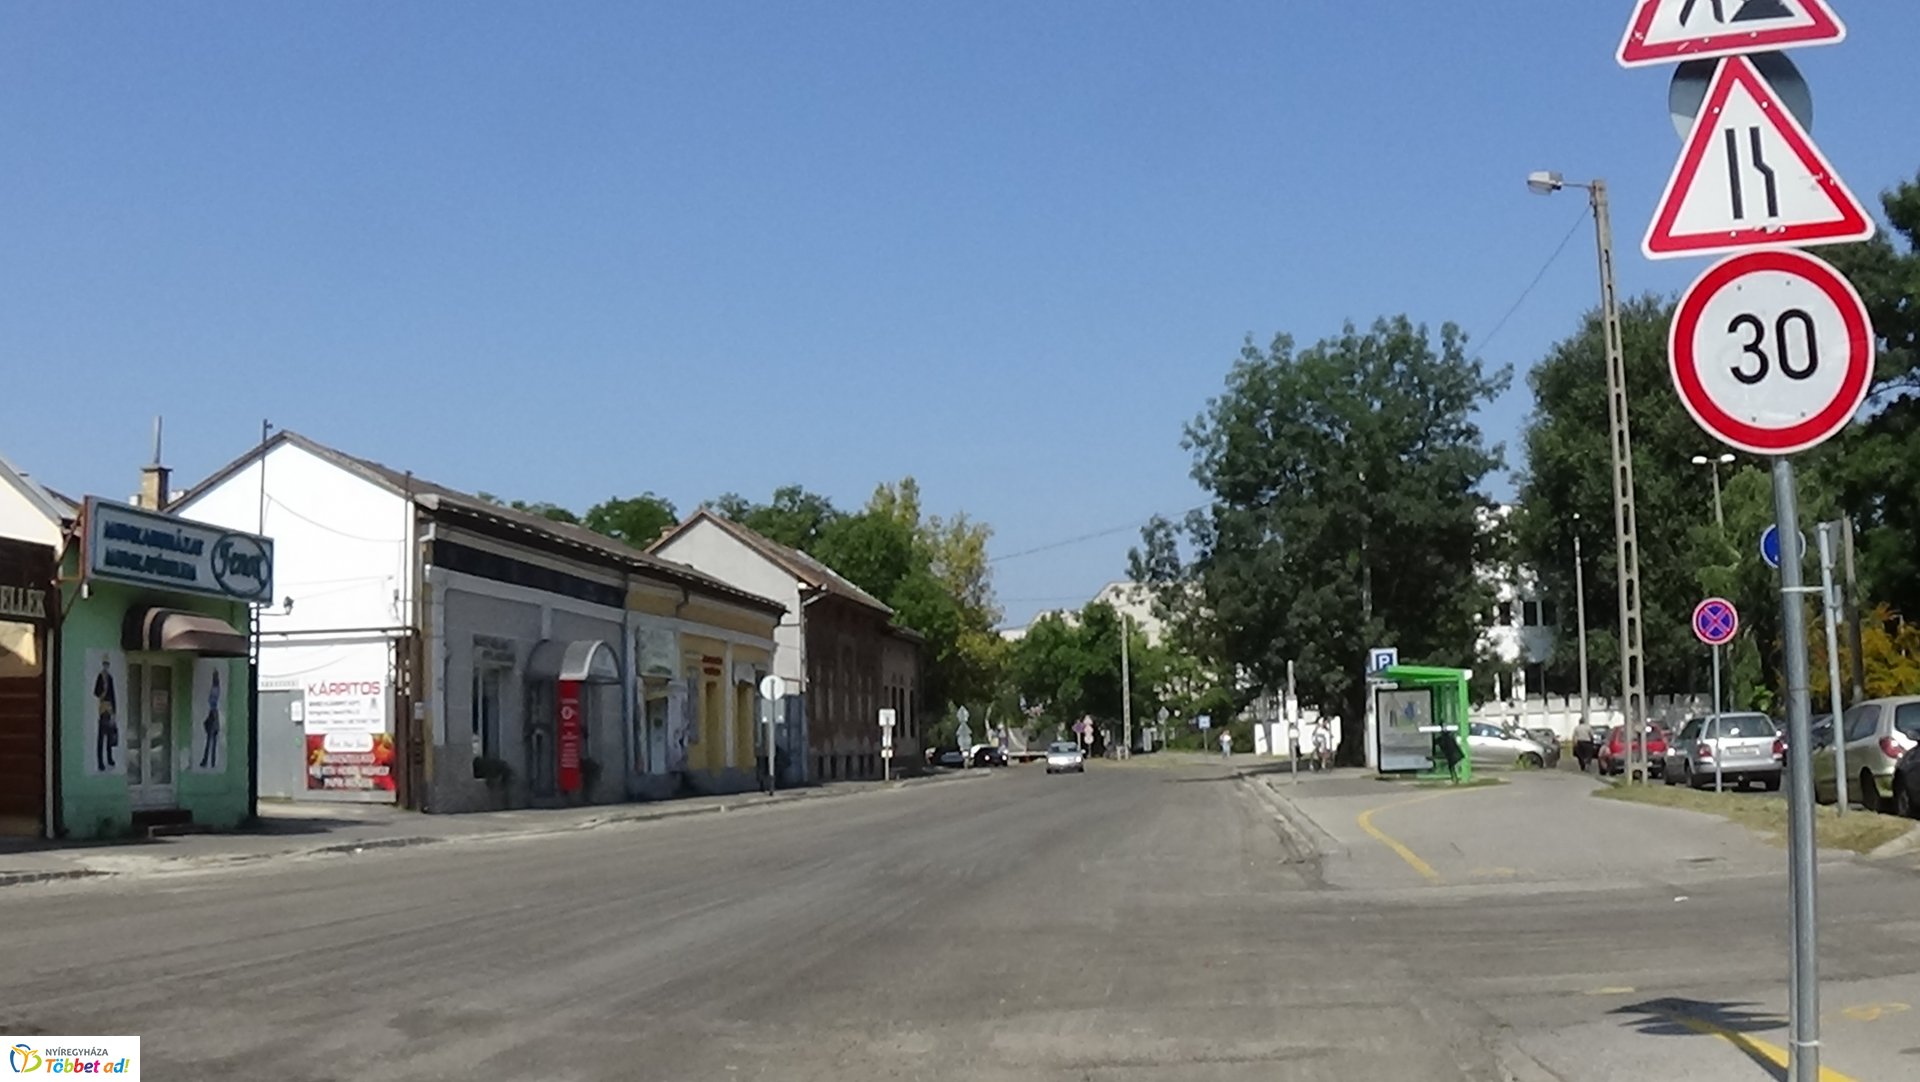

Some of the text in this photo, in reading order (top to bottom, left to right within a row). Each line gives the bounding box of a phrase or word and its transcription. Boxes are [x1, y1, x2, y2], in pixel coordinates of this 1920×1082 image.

[1727, 308, 1819, 385] 30
[1379, 655, 1390, 669] P
[308, 680, 381, 697] KÁRPITOS
